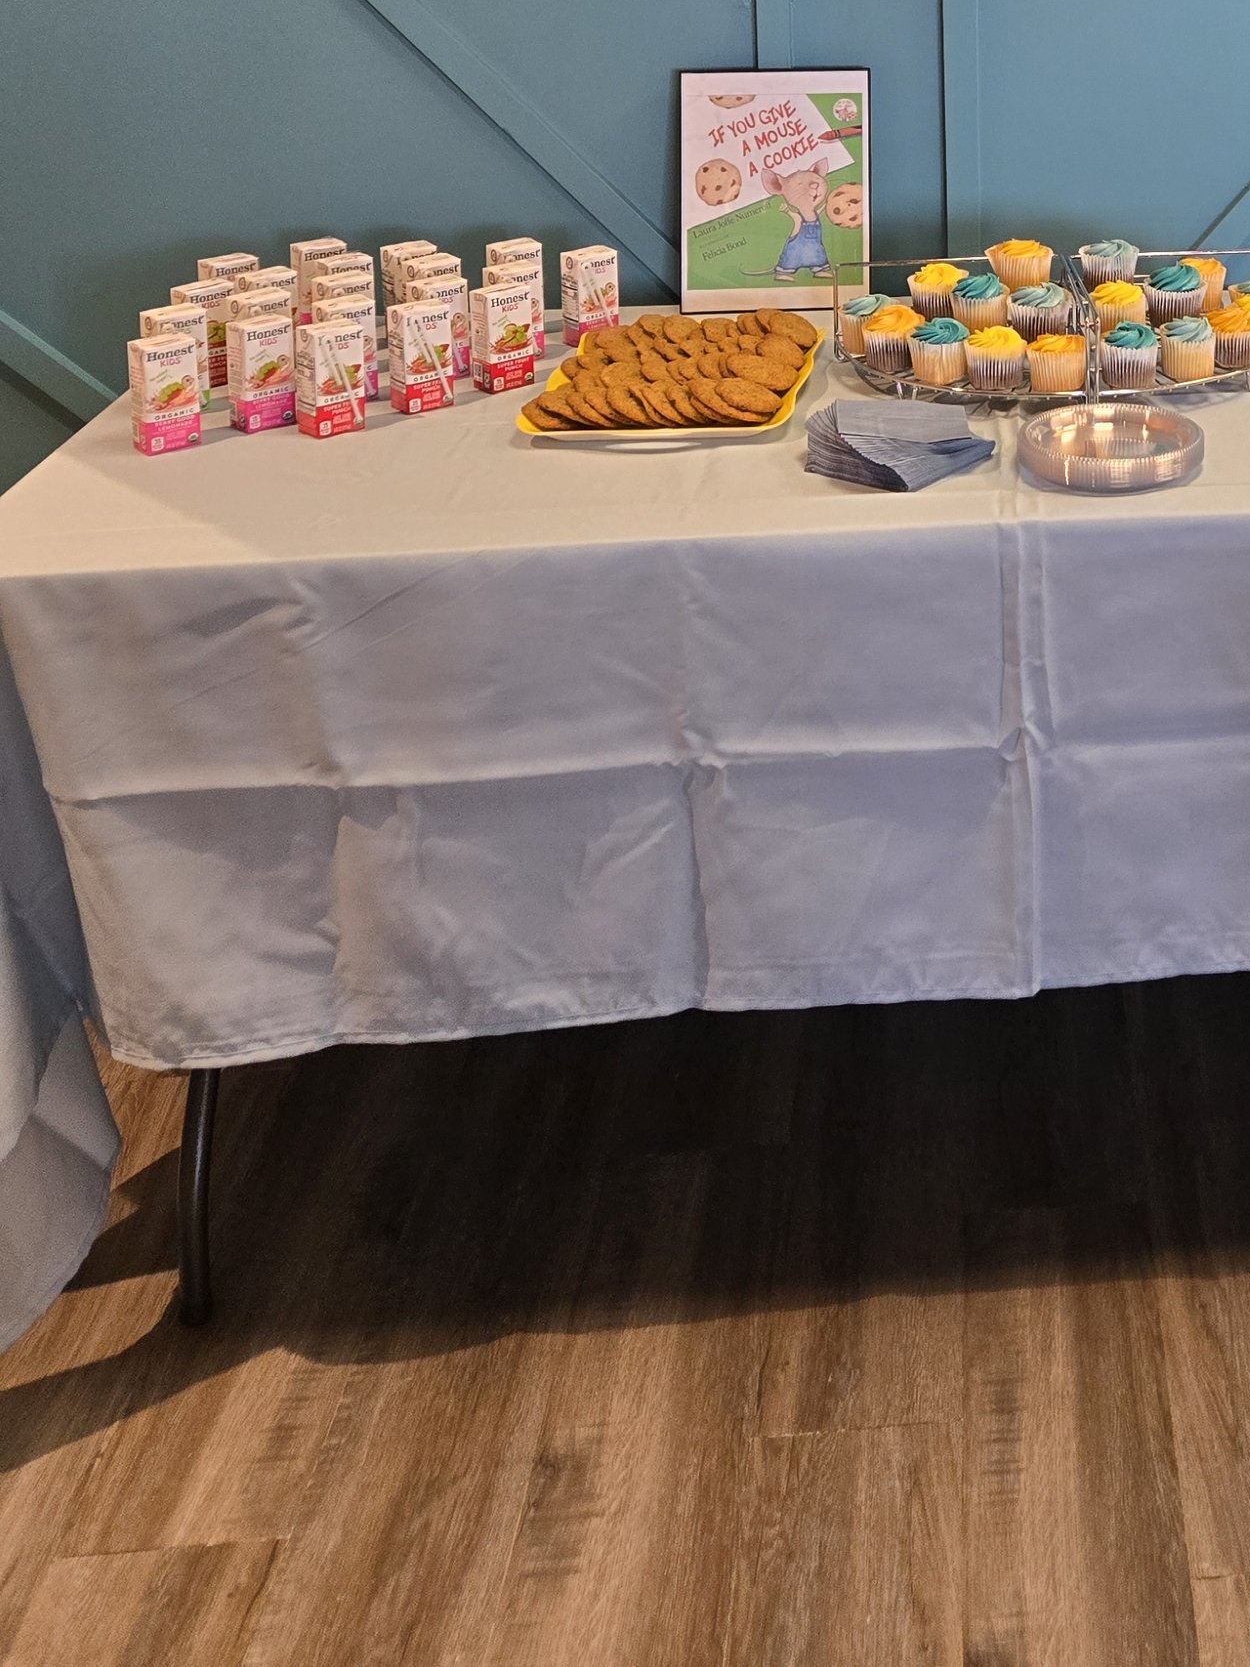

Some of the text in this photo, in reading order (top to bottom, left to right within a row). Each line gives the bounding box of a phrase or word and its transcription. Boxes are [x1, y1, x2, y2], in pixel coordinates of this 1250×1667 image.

[708, 100, 796, 147] IF YOU GIVE
[742, 118, 807, 157] A MOUSE
[748, 133, 819, 177] A COOKIE
[692, 225, 717, 239] Laura
[726, 237, 747, 251] Bond
[216, 262, 256, 277] Honest
[190, 288, 233, 304] Honest
[491, 292, 530, 308] Honest
[201, 301, 220, 310] KIDS
[502, 303, 519, 313] KIDS
[247, 324, 291, 342] Honest
[259, 337, 278, 347] KIDS
[146, 344, 194, 362] Honest
[497, 349, 530, 361] ORGANIC
[160, 356, 181, 368] KIDS
[155, 407, 194, 421] ORGANIC
